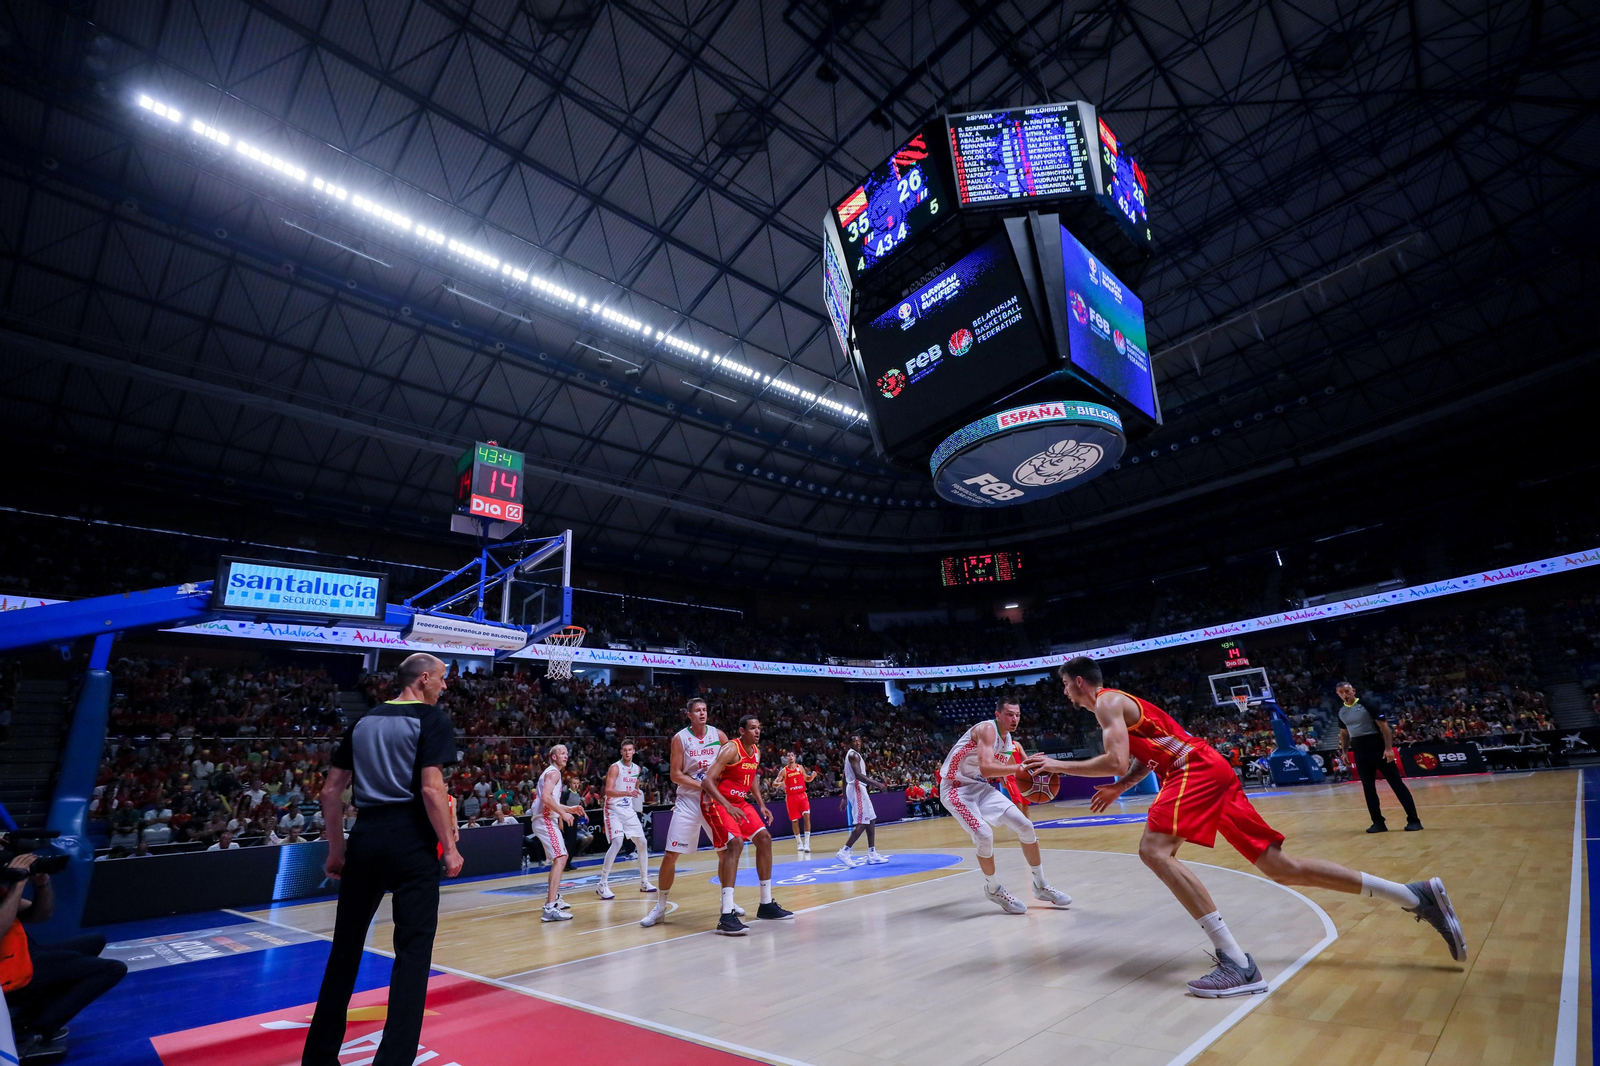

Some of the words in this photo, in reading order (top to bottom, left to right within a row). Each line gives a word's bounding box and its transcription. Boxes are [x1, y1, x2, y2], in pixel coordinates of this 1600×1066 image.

[1103, 145, 1117, 174] 35
[897, 169, 922, 203] 26
[930, 198, 938, 214] 5
[848, 211, 869, 242] 35
[1146, 228, 1151, 241] 5
[876, 222, 907, 257] 43.4
[857, 256, 866, 271] 4
[921, 273, 957, 302] EUROPEAN
[972, 295, 1018, 327] BELARUSIAN
[975, 304, 1022, 336] BASKETBALL
[977, 312, 1023, 343] FEDERATION
[1001, 404, 1064, 426] ESPAÑA
[479, 447, 512, 467] 43:4
[490, 470, 517, 498] 14
[1481, 565, 1541, 584] Andalucía
[230, 573, 377, 600] santalucía
[1409, 581, 1461, 598] Andalucía
[282, 595, 328, 606] SEGUROS
[262, 622, 327, 640] Andalucía
[1228, 648, 1240, 659] 14
[690, 748, 714, 757] BELARUS
